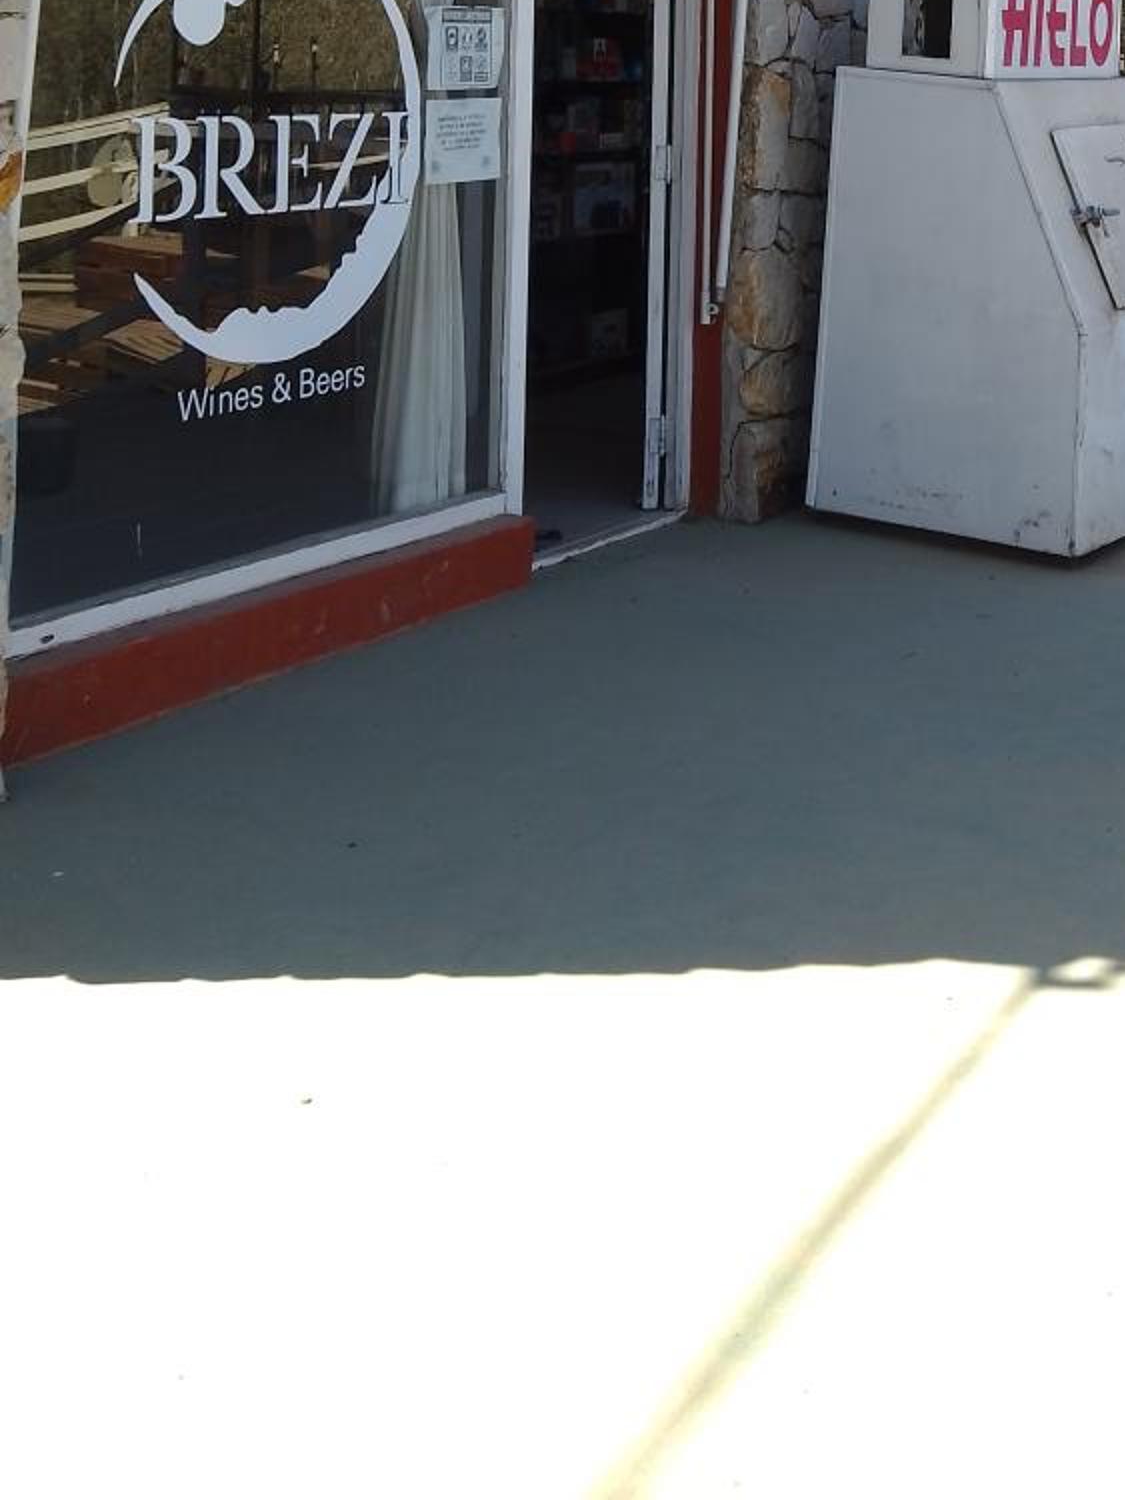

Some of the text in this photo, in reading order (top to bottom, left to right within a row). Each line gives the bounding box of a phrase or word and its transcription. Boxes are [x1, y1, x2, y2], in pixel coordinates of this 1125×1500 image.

[127, 110, 410, 224] BREZI
[177, 364, 365, 422] Wines & Beers
